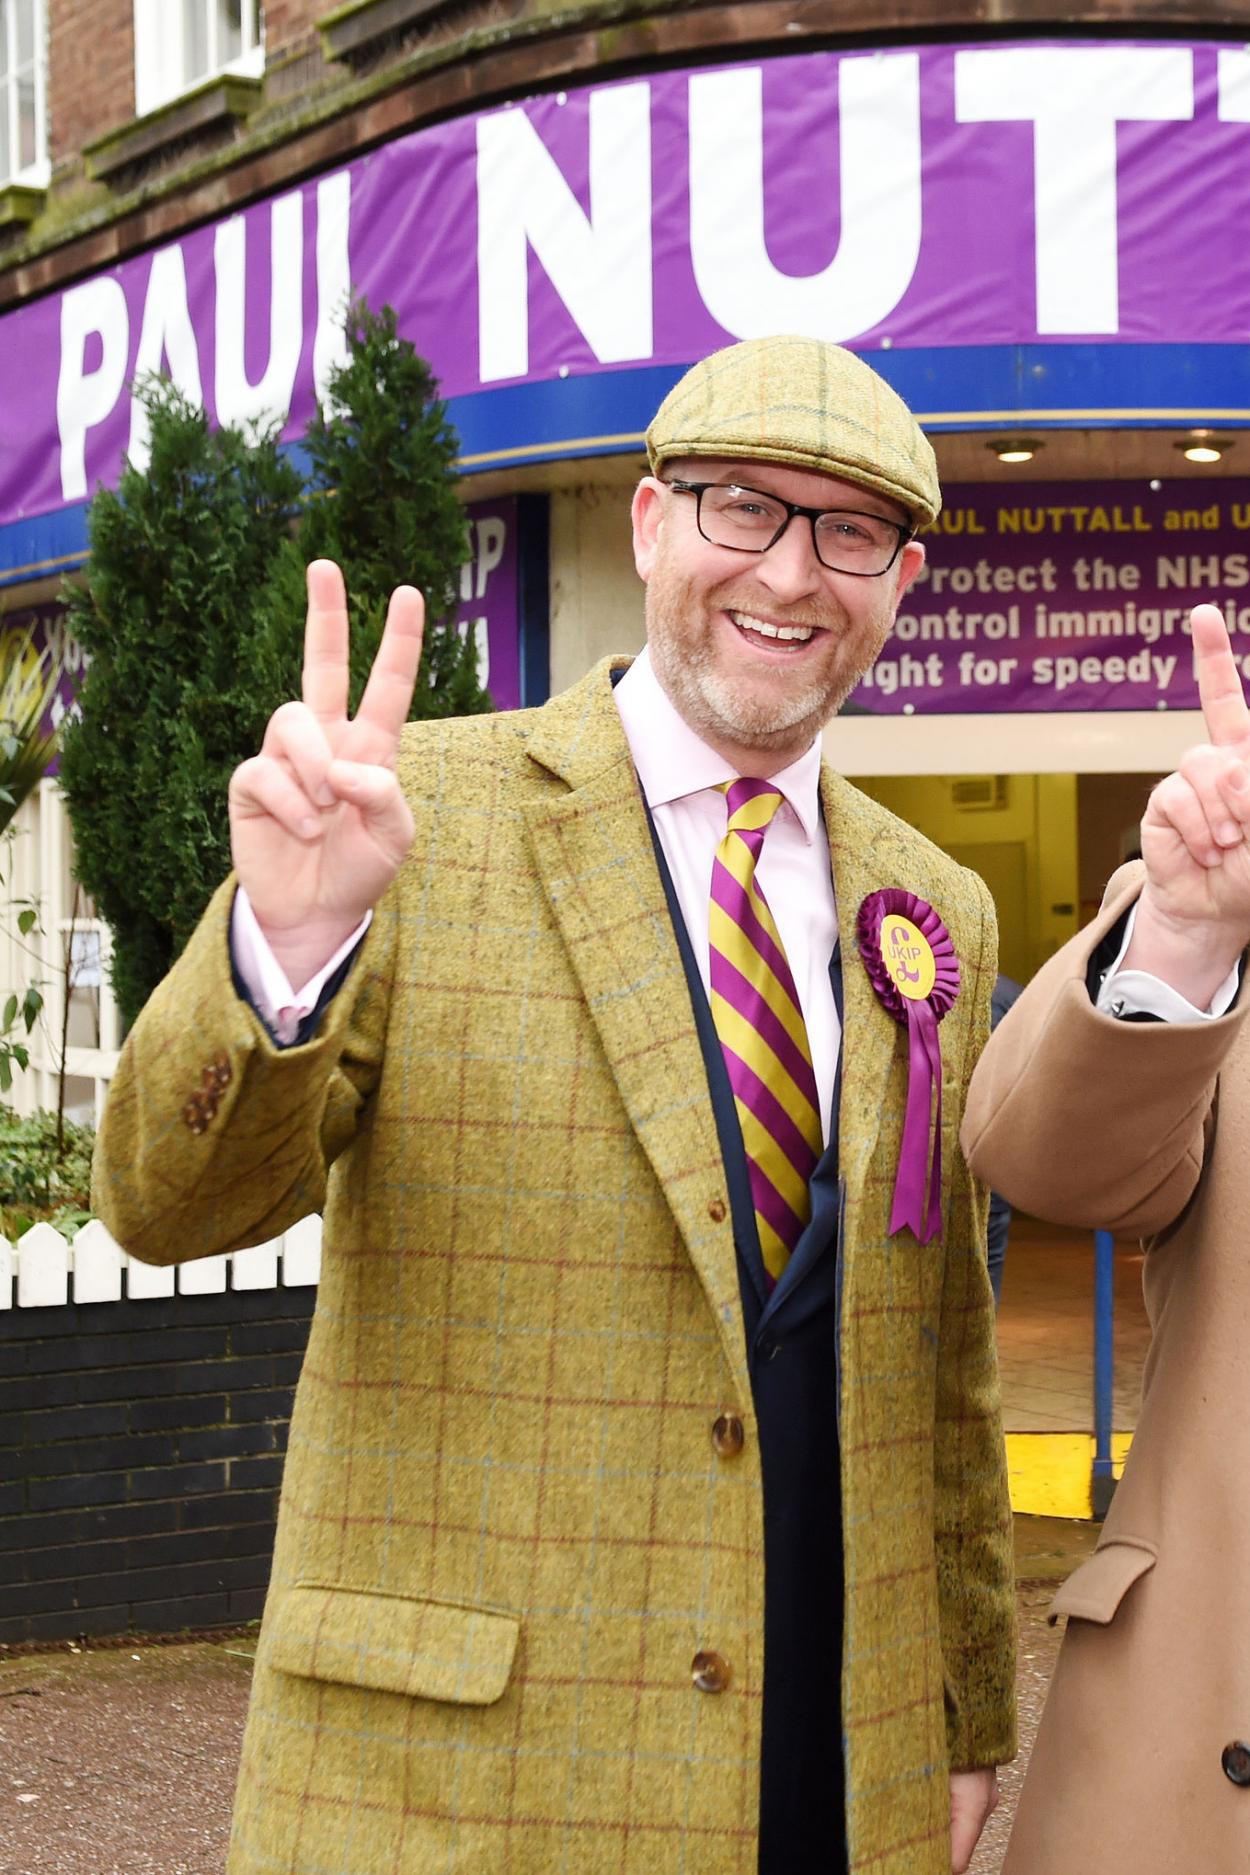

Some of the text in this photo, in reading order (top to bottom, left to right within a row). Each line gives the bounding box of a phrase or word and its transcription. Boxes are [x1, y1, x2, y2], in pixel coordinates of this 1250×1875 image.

[997, 506, 1152, 534] NUTTALL
[1163, 505, 1220, 531] and
[1073, 555, 1141, 592] the
[1156, 553, 1250, 589] NHS
[886, 604, 1020, 641] ontrol
[861, 652, 944, 695] ight
[958, 651, 1018, 686] for
[1031, 648, 1177, 691] speedy
[888, 946, 921, 961] UKIP
